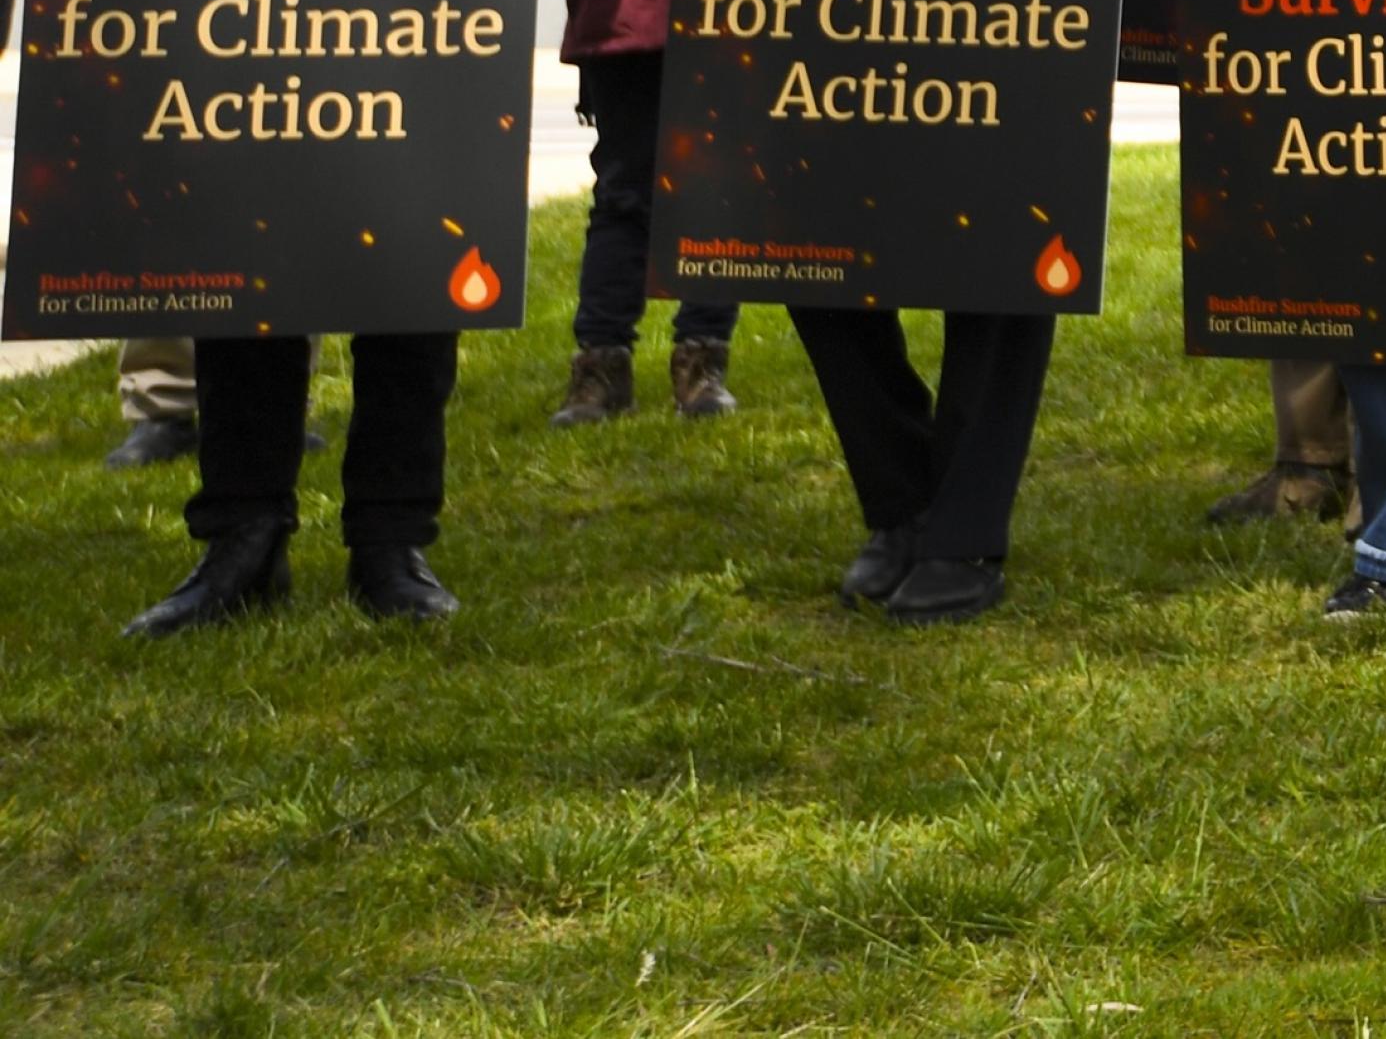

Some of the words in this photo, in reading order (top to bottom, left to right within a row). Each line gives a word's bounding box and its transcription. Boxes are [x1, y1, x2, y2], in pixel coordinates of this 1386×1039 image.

[1204, 33, 1290, 94] for
[771, 61, 998, 125] Action
[143, 76, 405, 141] Action
[680, 237, 760, 257] Bushfire
[764, 241, 854, 260] Survivors
[678, 257, 705, 276] for
[708, 258, 780, 278] Climate
[784, 262, 845, 281] Action
[40, 272, 135, 291] Bushfire
[140, 271, 245, 289] Survivors
[39, 295, 70, 313] for
[75, 293, 160, 312] Climate
[164, 292, 233, 310] Action
[1208, 295, 1277, 313] Bushfire
[1281, 298, 1361, 316] Survivors
[1209, 315, 1232, 332] for
[1235, 316, 1298, 334] Climate
[1300, 319, 1354, 337] Action
